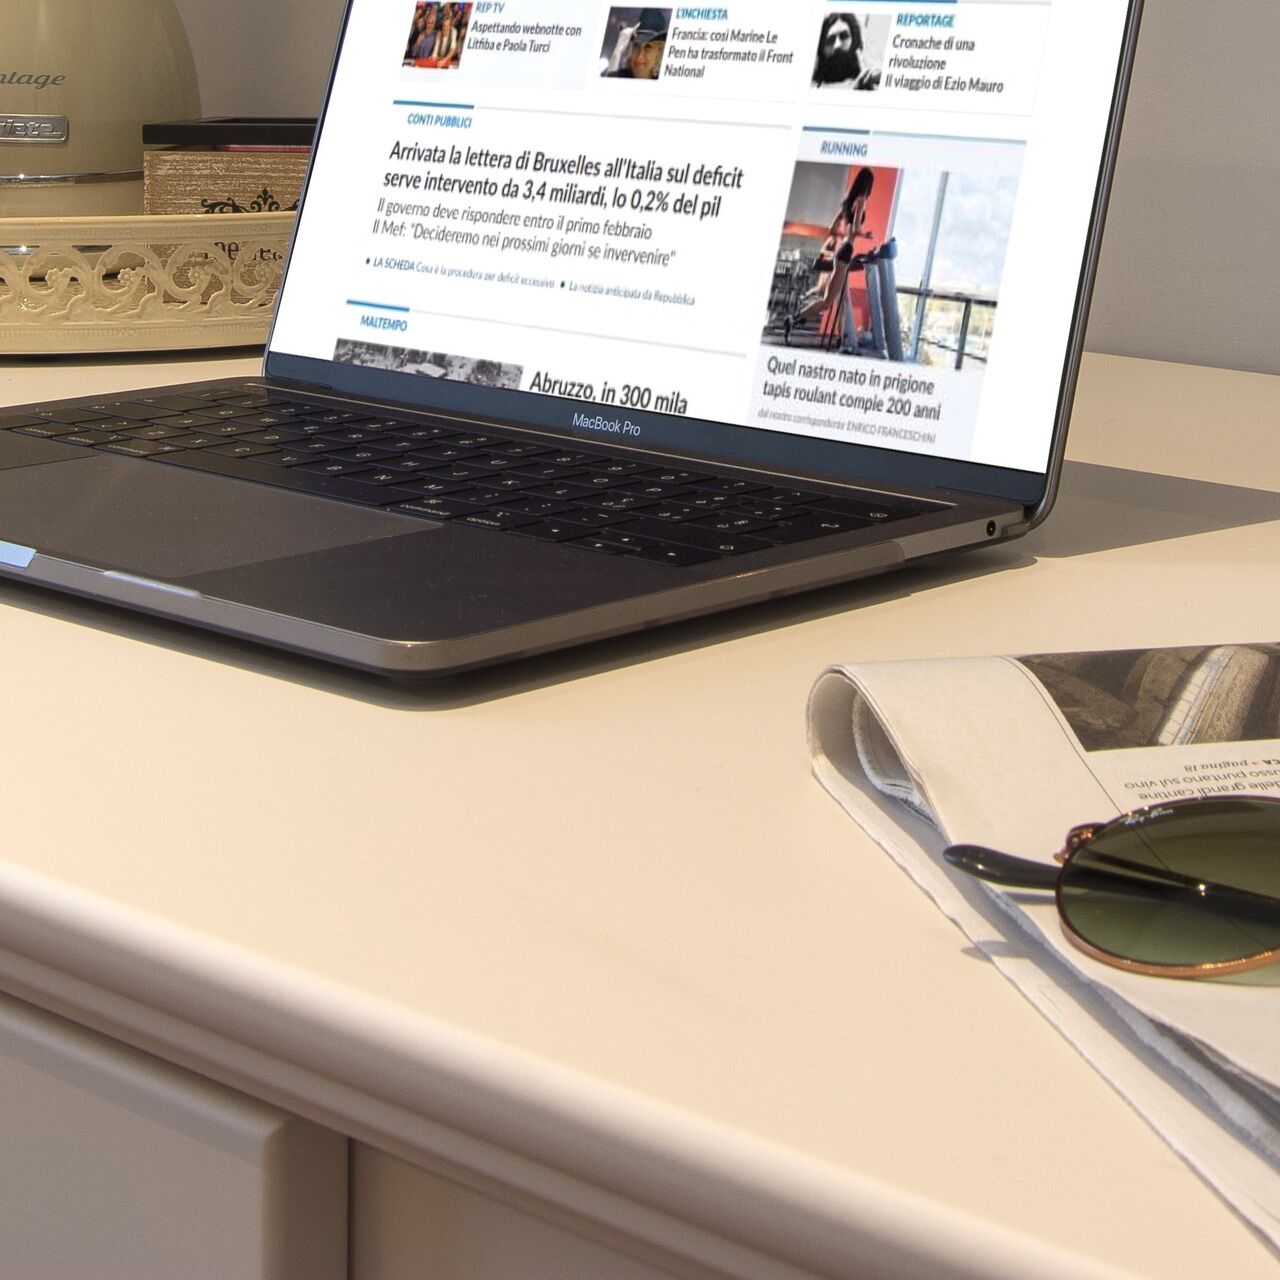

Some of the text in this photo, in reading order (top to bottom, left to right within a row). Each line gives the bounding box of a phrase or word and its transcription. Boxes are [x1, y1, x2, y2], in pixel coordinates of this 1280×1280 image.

[475, 2, 505, 14] REP TV
[676, 8, 728, 21] L'INCHIESTA
[471, 21, 582, 37] Aspettando webnotte con
[896, 13, 956, 28] REPORTAGE
[671, 27, 708, 41] Francia:
[730, 29, 765, 43] Marine
[766, 31, 778, 44] Le
[892, 34, 975, 51] Cronache di una
[467, 38, 495, 51] Litfiba
[502, 39, 527, 52] Paola
[529, 41, 551, 53] Turci
[668, 46, 686, 59] Pen
[687, 47, 699, 60] ha
[701, 47, 757, 62] trasformato
[766, 49, 794, 64] Front
[888, 56, 946, 70] rivoluzione
[664, 65, 705, 78] National
[885, 74, 1004, 93] Il viaggio di Ezio Mauro
[407, 113, 472, 128] CONTI PUBBLICI
[820, 140, 868, 157] RUNNING
[389, 140, 744, 189] Arrivata la lettera di Bruxelles all'Italia sul deficit
[383, 171, 722, 220] serve intervento da 3,4 miliardi, lo 0,2% del pil
[377, 198, 653, 240] Il governo deve rispondere entro il primo febbraio
[372, 219, 380, 234] Il
[381, 220, 407, 238] Mef:
[482, 232, 502, 248] nei
[501, 234, 550, 253] prossimi
[550, 238, 585, 258] giorni
[587, 245, 601, 260] se
[360, 315, 408, 332] MALTEMPO
[767, 356, 935, 396] Quel nastro nato in prigione
[529, 370, 689, 415] Abruzzo, in 300 mila
[763, 381, 942, 421] tapis roulant compie 200 anni
[571, 412, 641, 437] MacBook Pro
[1124, 780, 1160, 791] vino
[1159, 778, 1181, 789] sul
[1182, 770, 1247, 785] puntano
[1197, 781, 1246, 798] grandi
